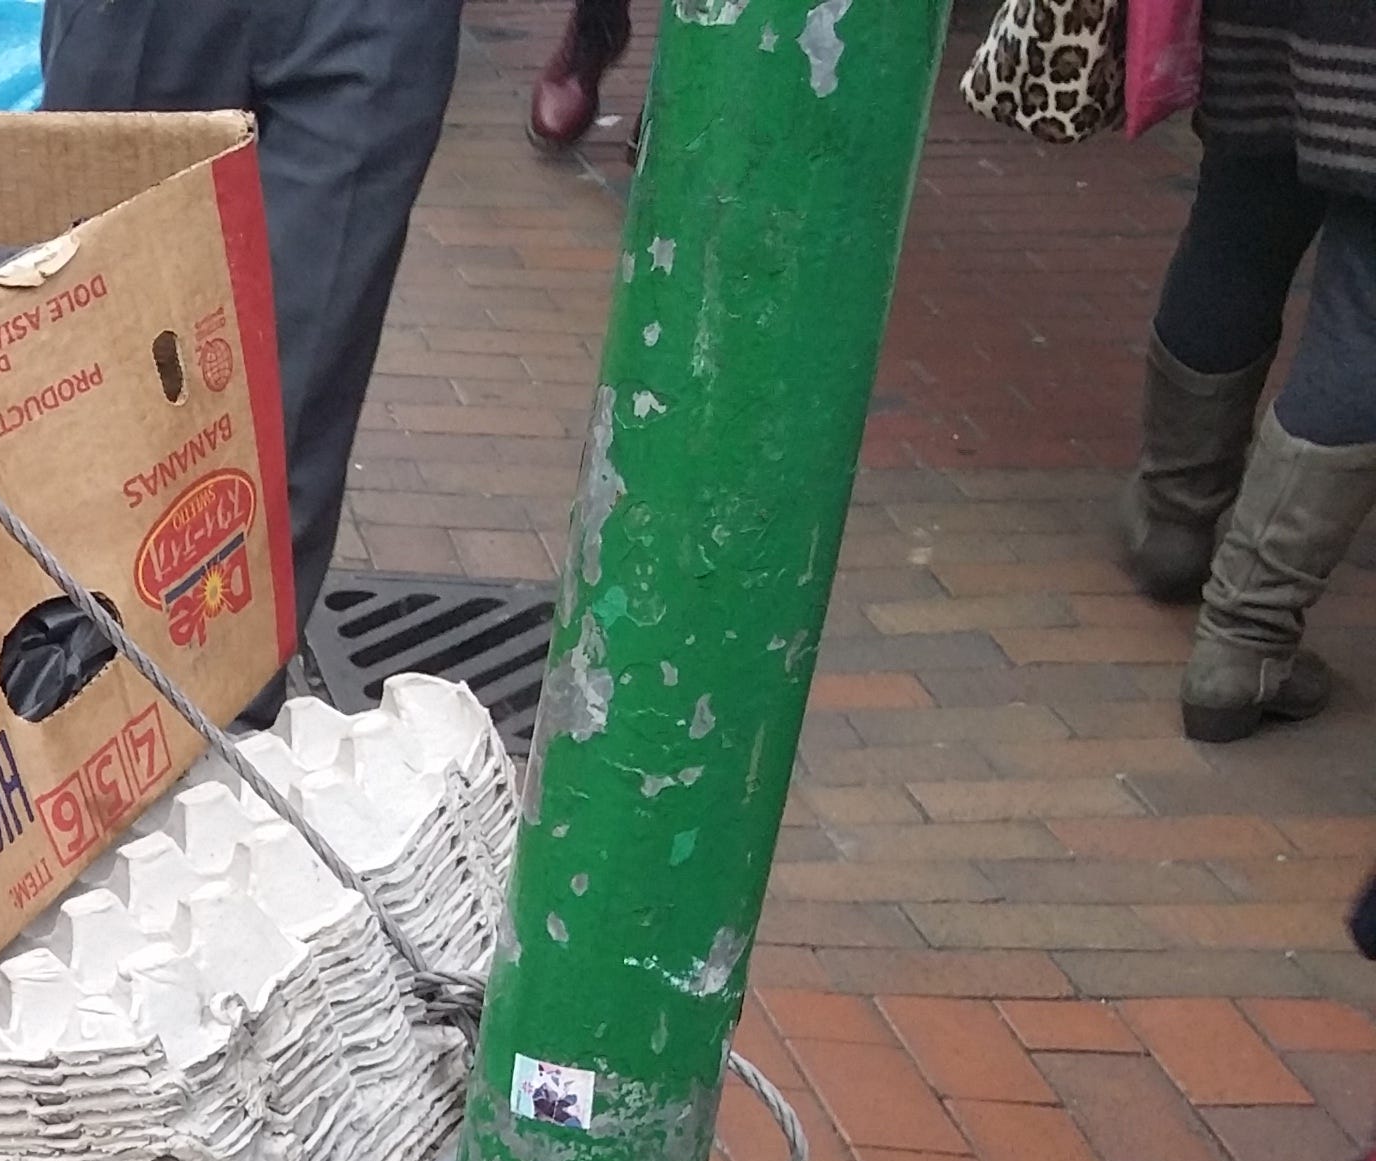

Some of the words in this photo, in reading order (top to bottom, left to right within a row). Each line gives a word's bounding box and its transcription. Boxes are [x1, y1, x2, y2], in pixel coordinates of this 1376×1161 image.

[47, 274, 109, 322] DOLE
[123, 412, 234, 510] BANANAS
[8, 859, 53, 908] ITEM:
